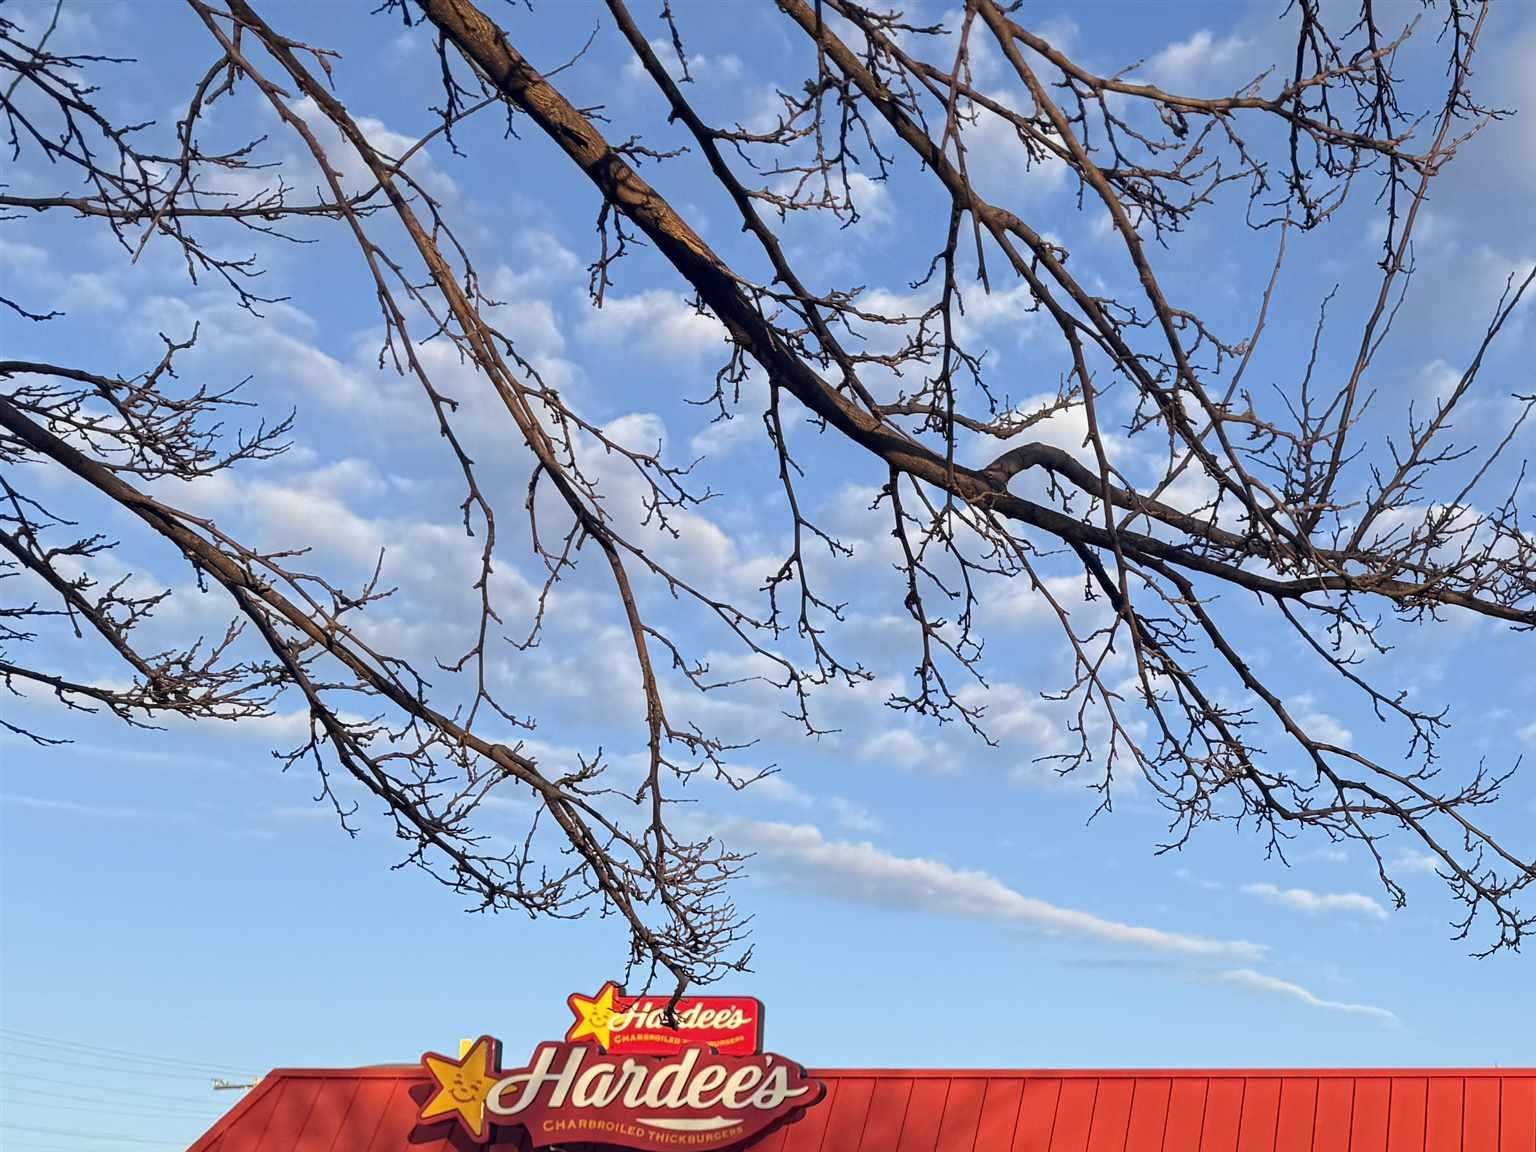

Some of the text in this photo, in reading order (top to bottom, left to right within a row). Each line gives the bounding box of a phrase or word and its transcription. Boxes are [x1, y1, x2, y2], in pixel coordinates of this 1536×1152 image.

[486, 1047, 808, 1115] Hardee's
[543, 1119, 744, 1144] CHARBROILED THICKBURGERS
